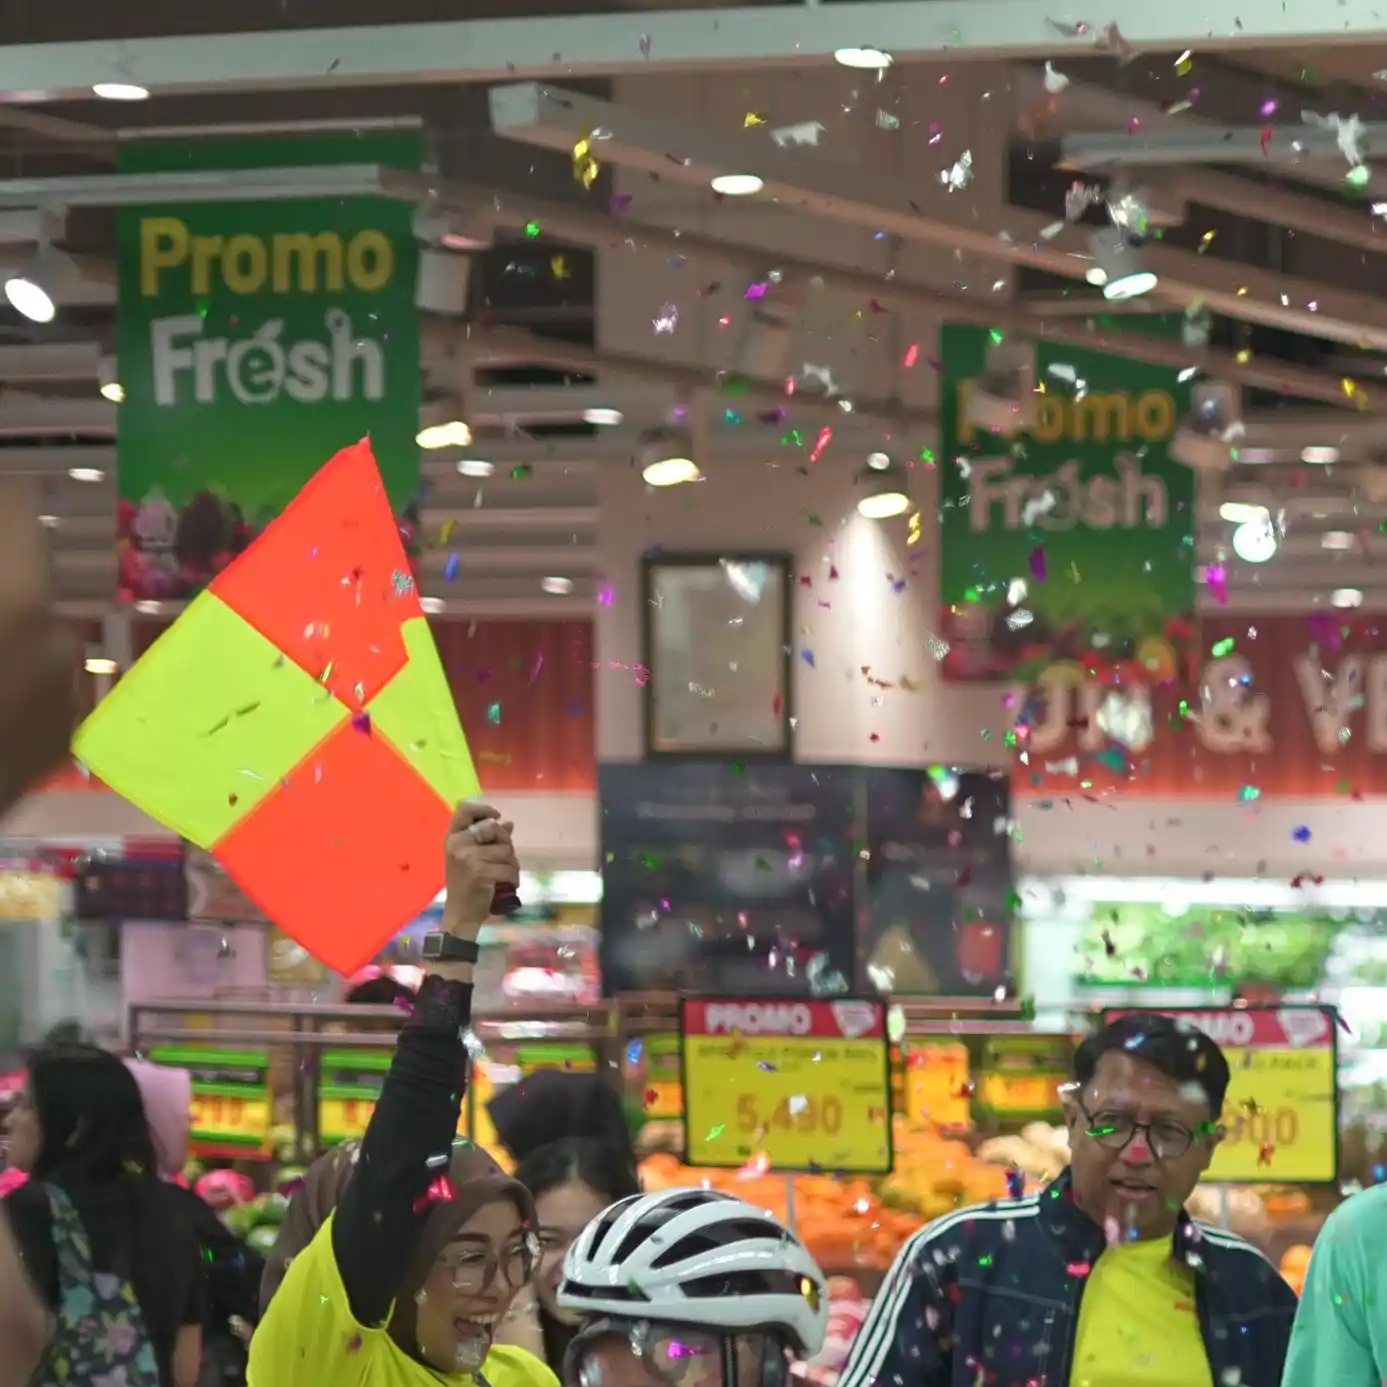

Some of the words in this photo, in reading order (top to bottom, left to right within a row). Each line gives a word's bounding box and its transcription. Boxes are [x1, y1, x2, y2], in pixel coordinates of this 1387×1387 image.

[139, 216, 394, 297] Promo
[151, 306, 387, 406] Fresh
[969, 451, 1168, 532] Fresh
[705, 1002, 812, 1035] PROMO
